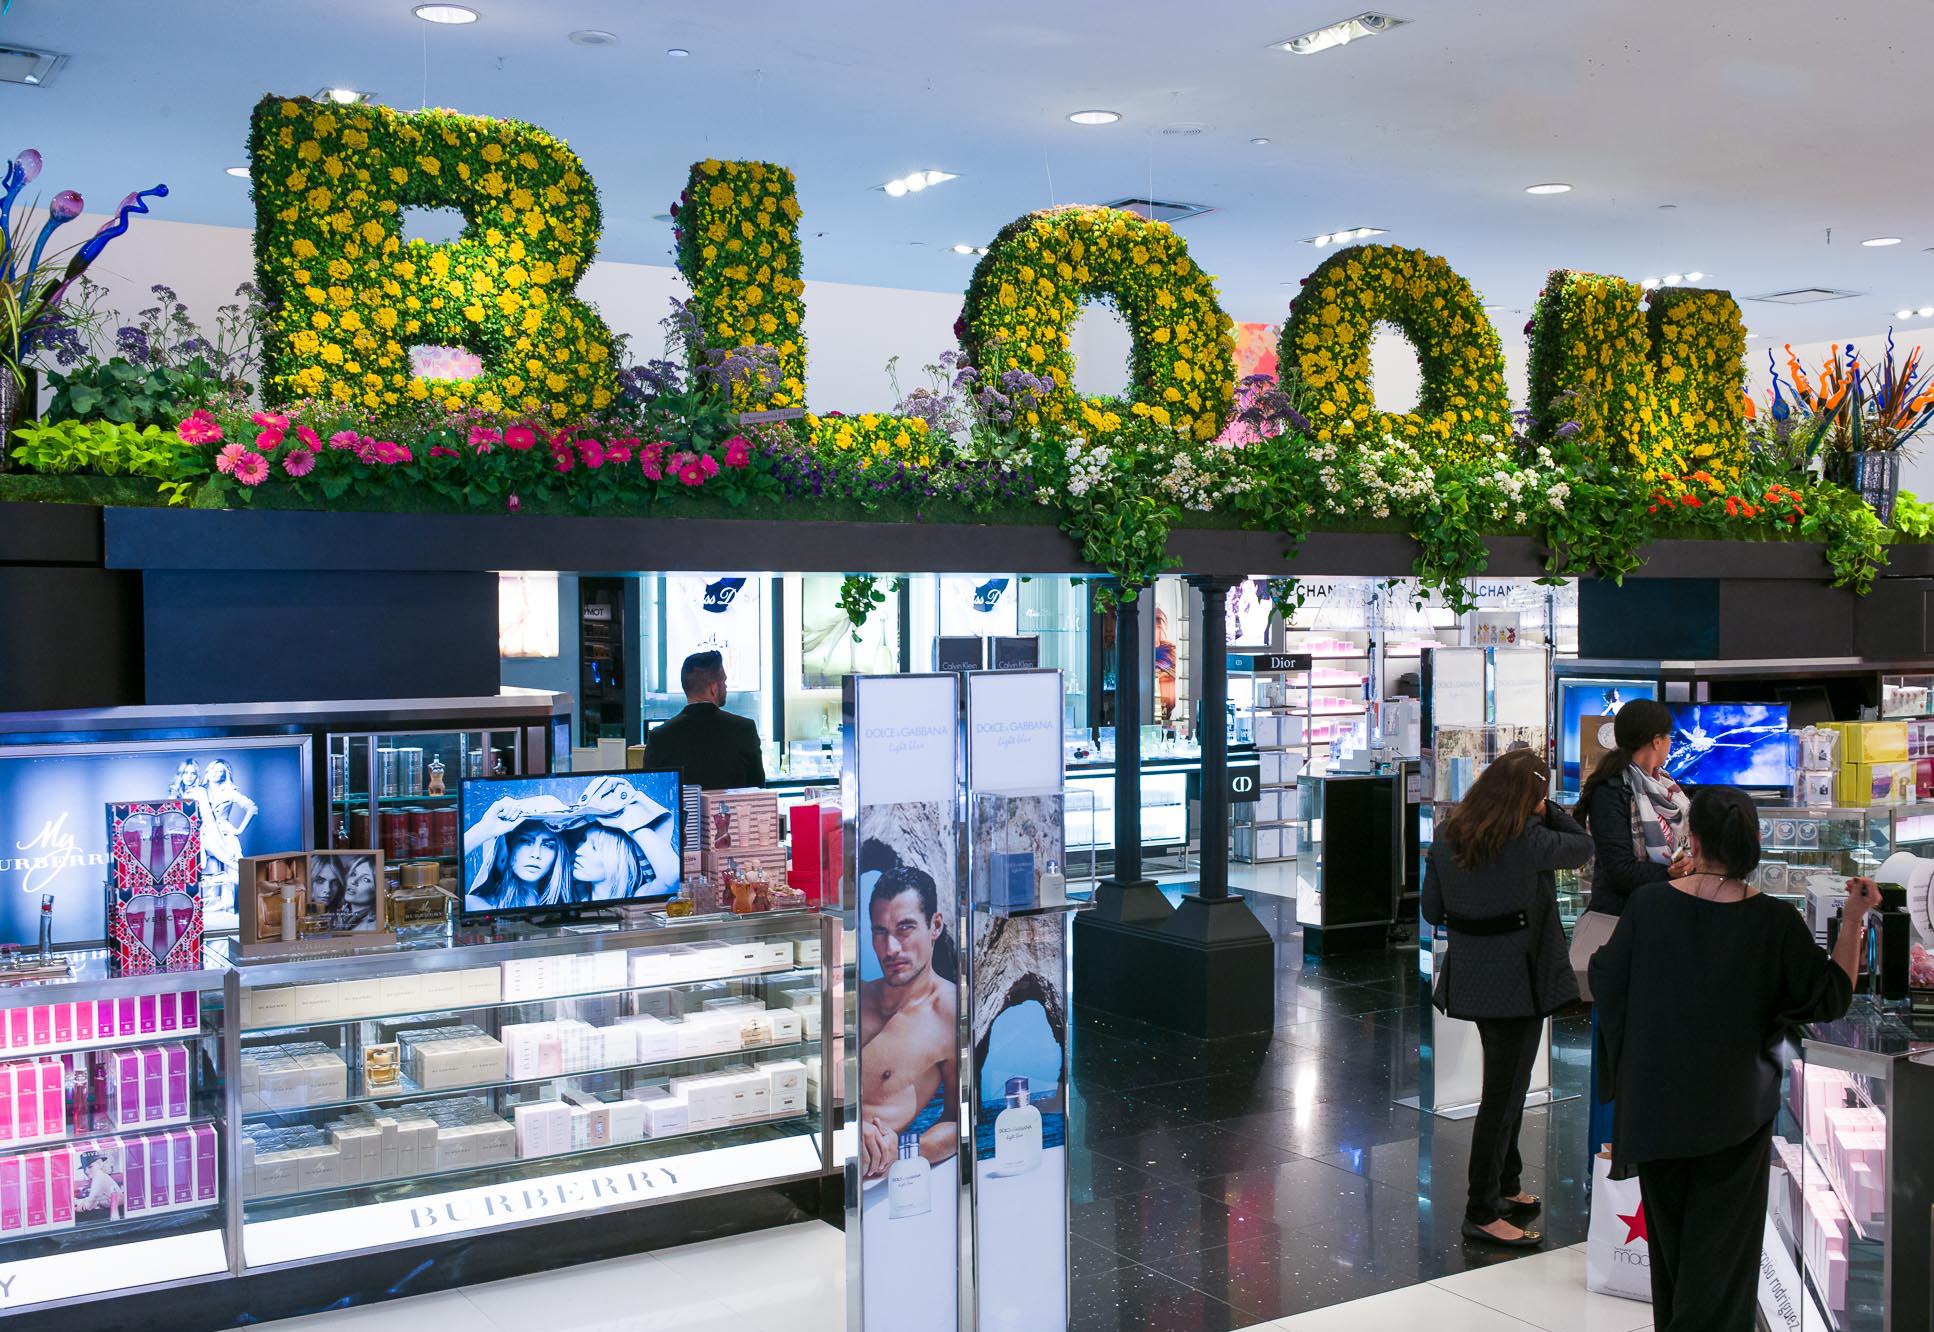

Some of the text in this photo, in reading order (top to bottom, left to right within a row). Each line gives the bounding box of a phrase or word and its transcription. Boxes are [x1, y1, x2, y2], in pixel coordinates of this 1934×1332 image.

[249, 93, 1749, 490] BLOOM
[1297, 584, 1336, 597] CHAN
[1479, 585, 1515, 597] CHAN
[942, 661, 978, 671] Calvin Klein
[1271, 656, 1296, 669] Dior
[16, 811, 84, 893] My
[0, 853, 113, 872] URBERR
[409, 1167, 682, 1230] BURBERRY
[1614, 1251, 1650, 1267] mac
[1769, 1276, 1801, 1332] rodriguez
